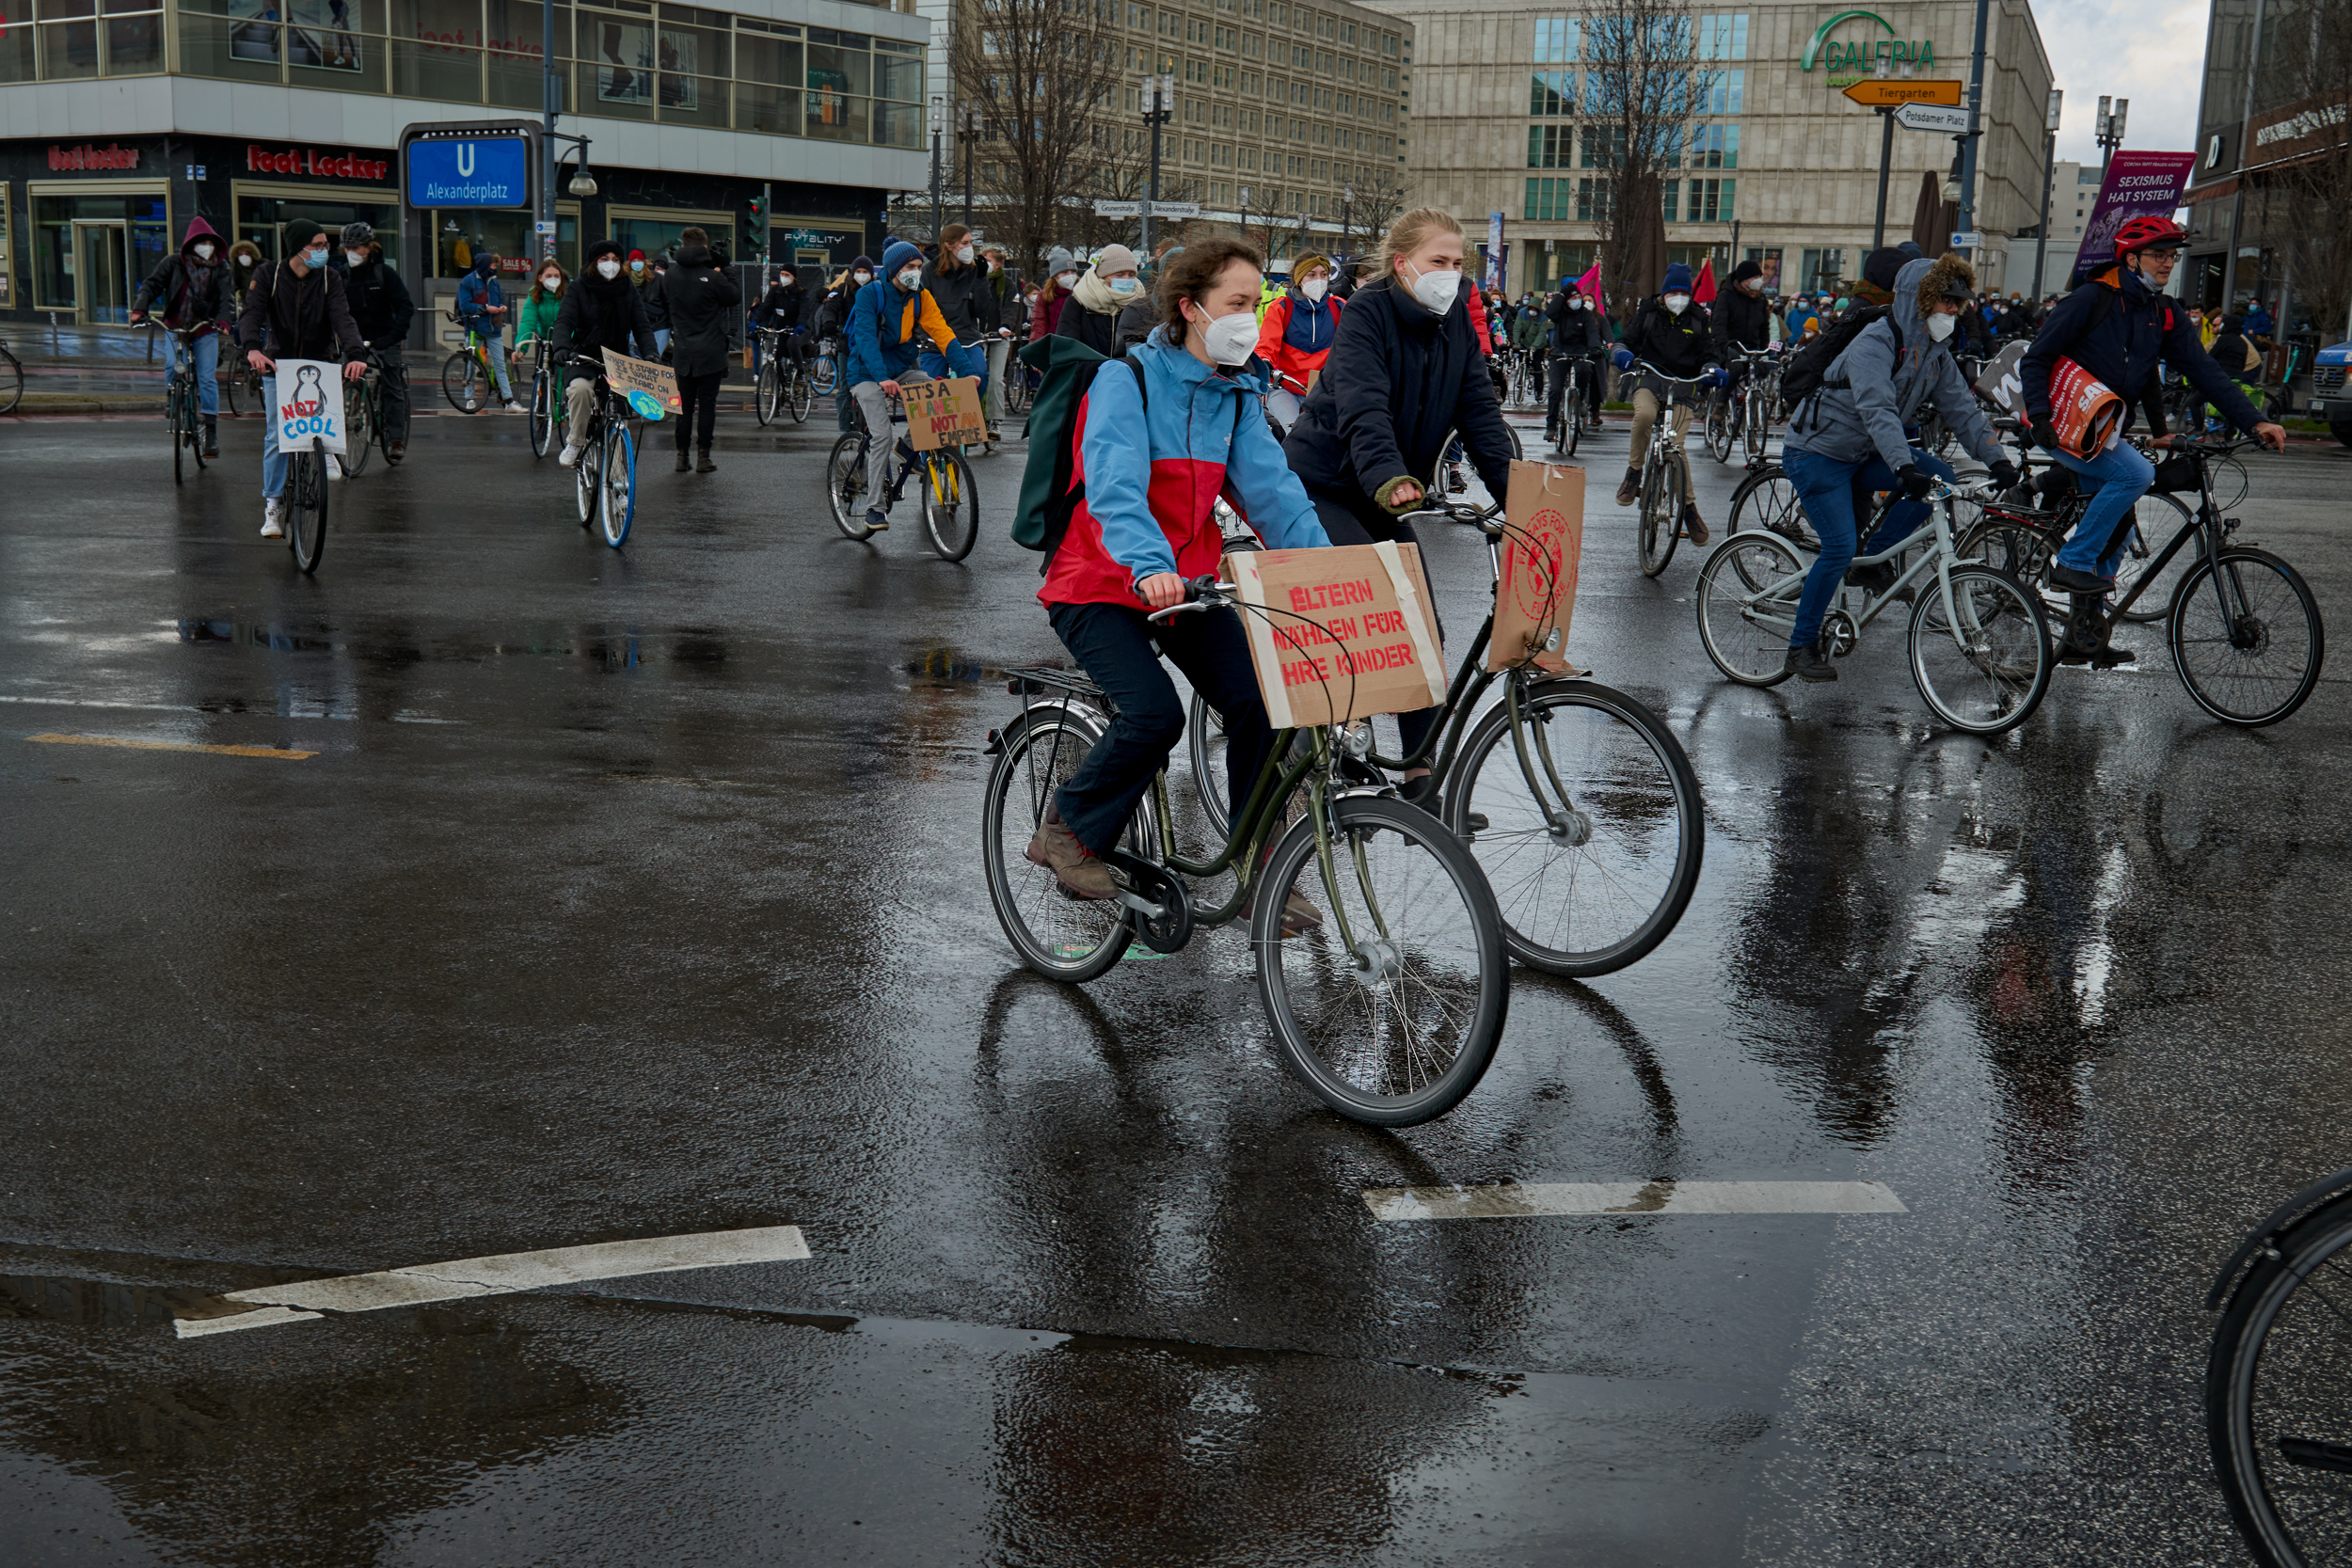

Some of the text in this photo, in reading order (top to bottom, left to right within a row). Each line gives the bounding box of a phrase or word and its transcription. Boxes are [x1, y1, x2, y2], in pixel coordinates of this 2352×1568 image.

[1825, 40, 1934, 71] GALERIA
[1878, 87, 1935, 100] Tiergarten
[1906, 111, 1965, 126] Potsdamer Platz
[457, 143, 475, 178] U
[2118, 174, 2174, 187] SEXISMUS
[426, 182, 509, 203] Alexanderplatz
[2107, 192, 2131, 203] HAT
[2132, 189, 2175, 201] SYSTEM
[1101, 204, 1135, 213] Grunerstraße
[1153, 205, 1195, 215] Alexanderstraße
[502, 259, 519, 267] SALE
[603, 353, 626, 367] WHAT
[636, 364, 659, 376] STAND
[627, 376, 654, 389] STAND
[658, 385, 669, 394] ON
[631, 370, 658, 383] WHAT
[902, 382, 951, 402] IT'S A
[281, 400, 317, 420] NOT
[909, 396, 961, 419] PLANET
[283, 416, 337, 439] COOL
[930, 412, 979, 433] NOT AN
[938, 427, 982, 446] EMPIRE
[1549, 515, 1565, 538] FOR
[1289, 578, 1374, 612] ELTERN
[1363, 610, 1406, 637] FÜR
[1282, 643, 1414, 687] HRE KINDER
